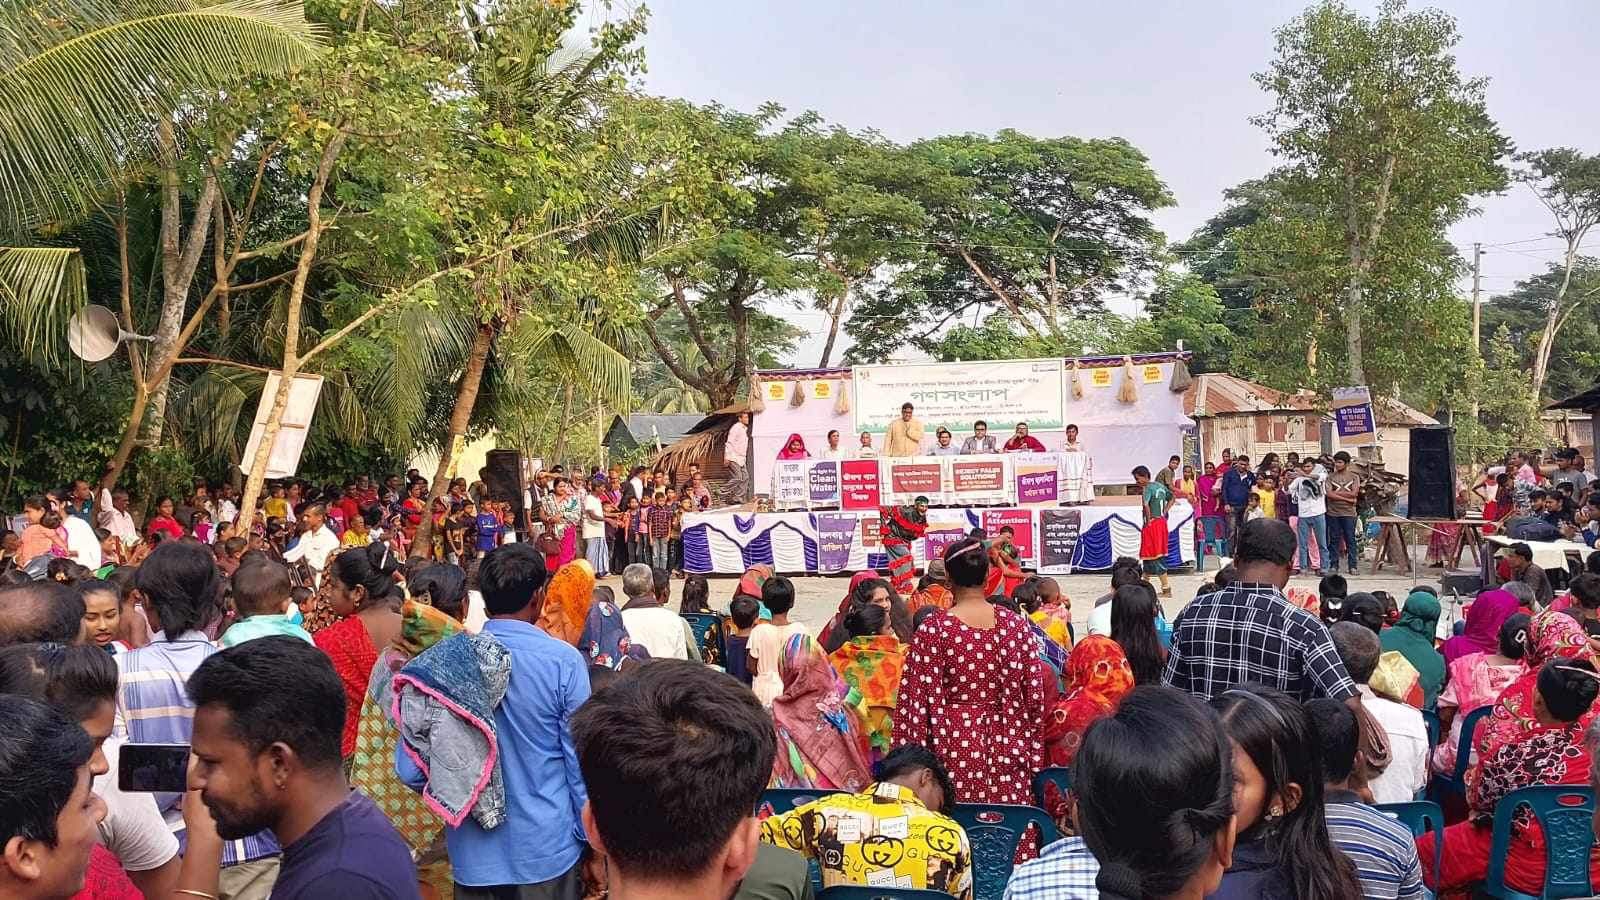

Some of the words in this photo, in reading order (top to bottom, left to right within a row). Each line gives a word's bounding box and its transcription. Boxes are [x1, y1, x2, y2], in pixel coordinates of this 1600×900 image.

[910, 388, 1009, 403] গণসংলাপ
[811, 475, 836, 483] Clean
[959, 473, 996, 481] SOLUTIONS
[810, 484, 836, 492] Water
[986, 511, 1003, 519] Pay
